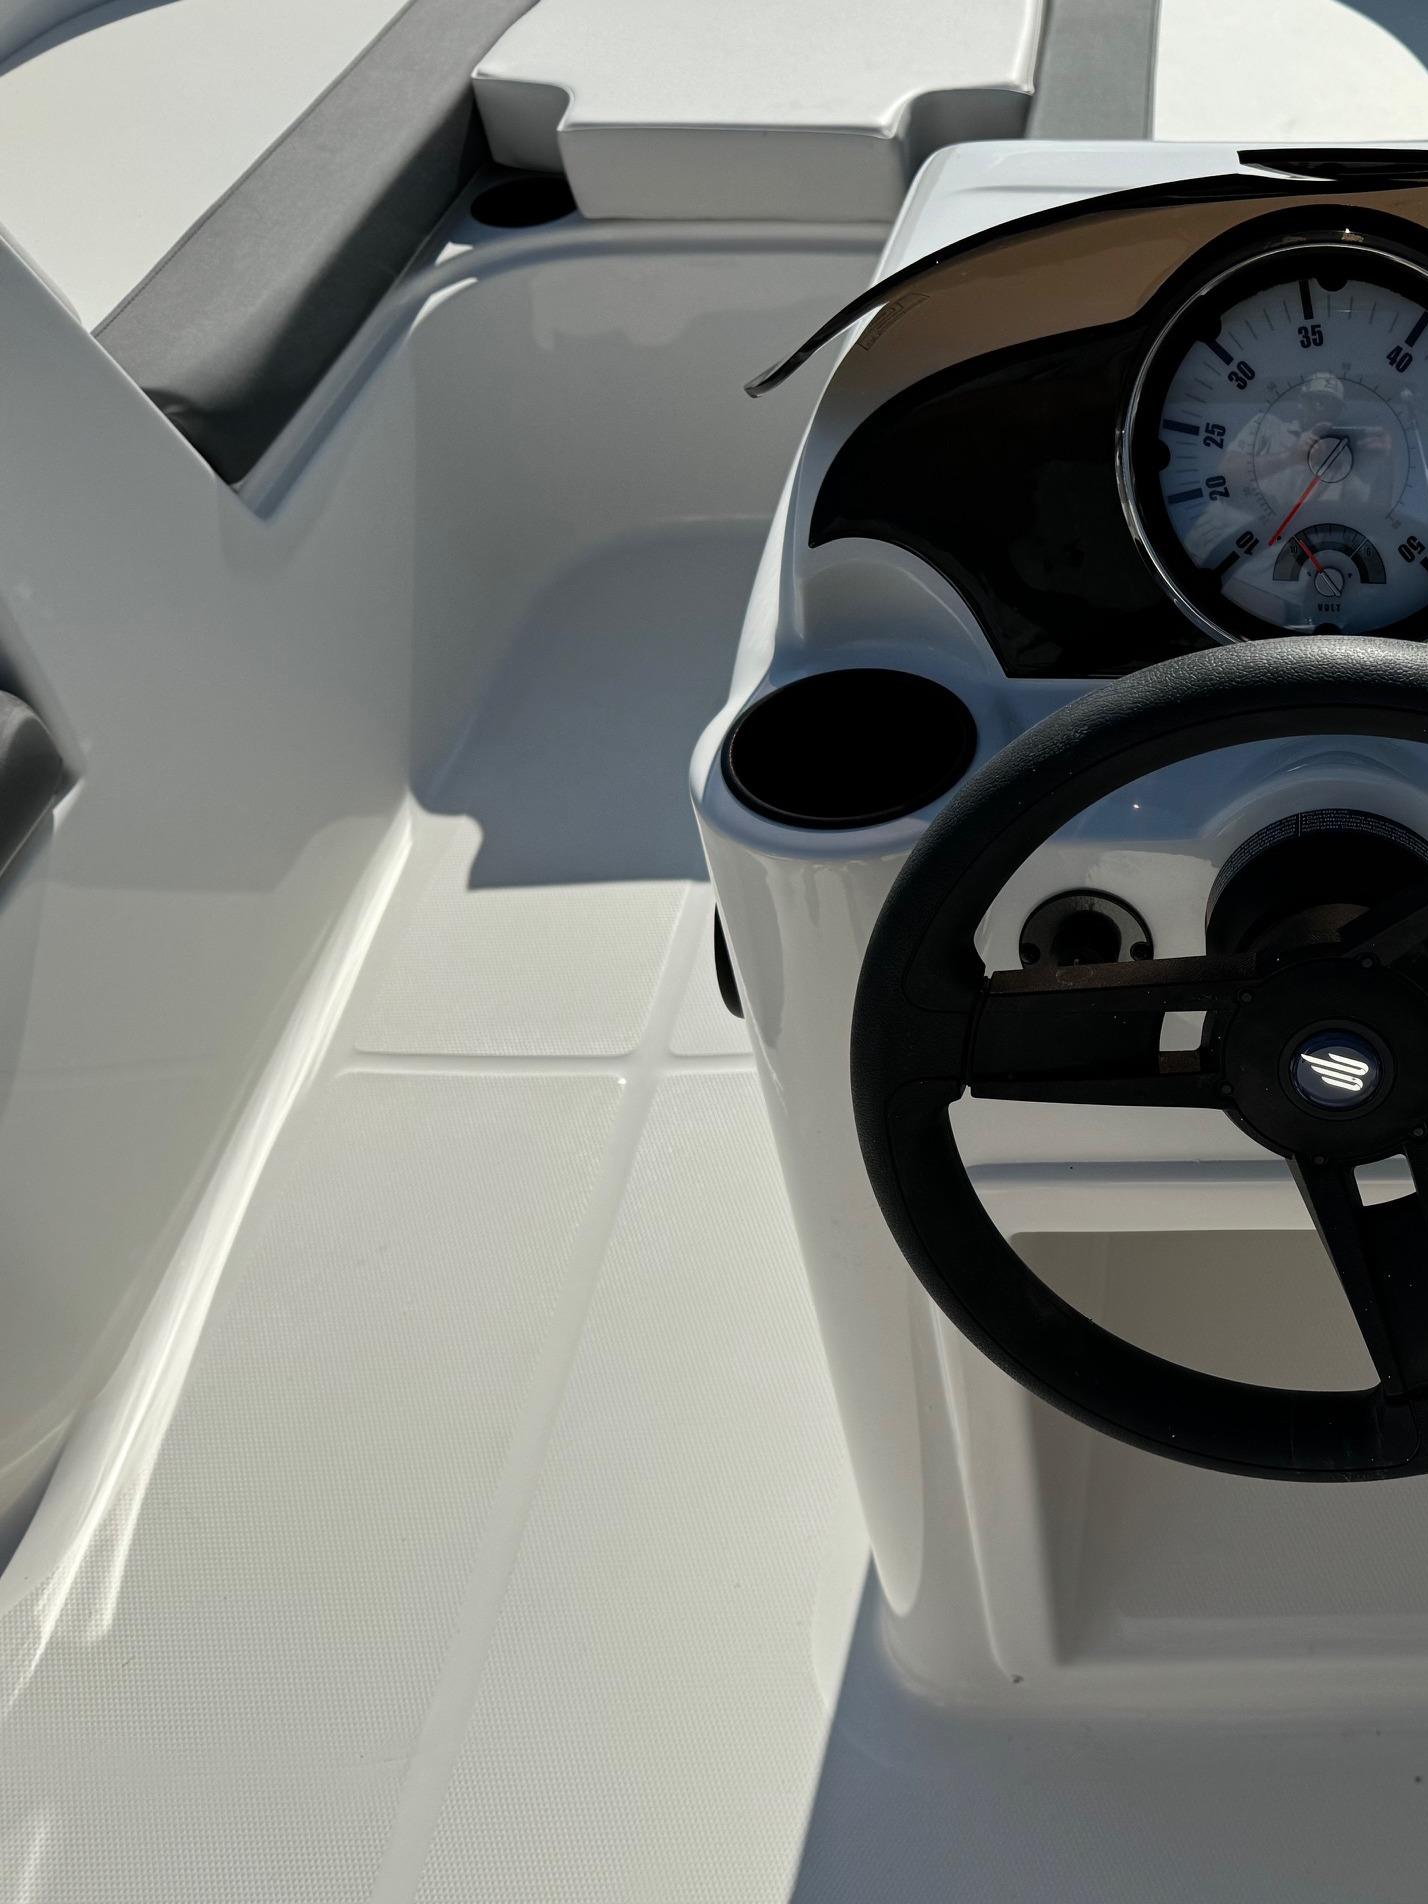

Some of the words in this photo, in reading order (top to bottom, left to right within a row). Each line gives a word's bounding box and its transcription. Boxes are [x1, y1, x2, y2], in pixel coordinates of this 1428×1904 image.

[1298, 325, 1324, 349] 35
[1386, 344, 1413, 373] 40
[1228, 361, 1256, 390] 30
[1203, 422, 1227, 450] 25
[1205, 474, 1230, 502] 20
[1235, 530, 1260, 557] 10
[1397, 535, 1426, 564] 50
[1317, 603, 1341, 612] VOLT
